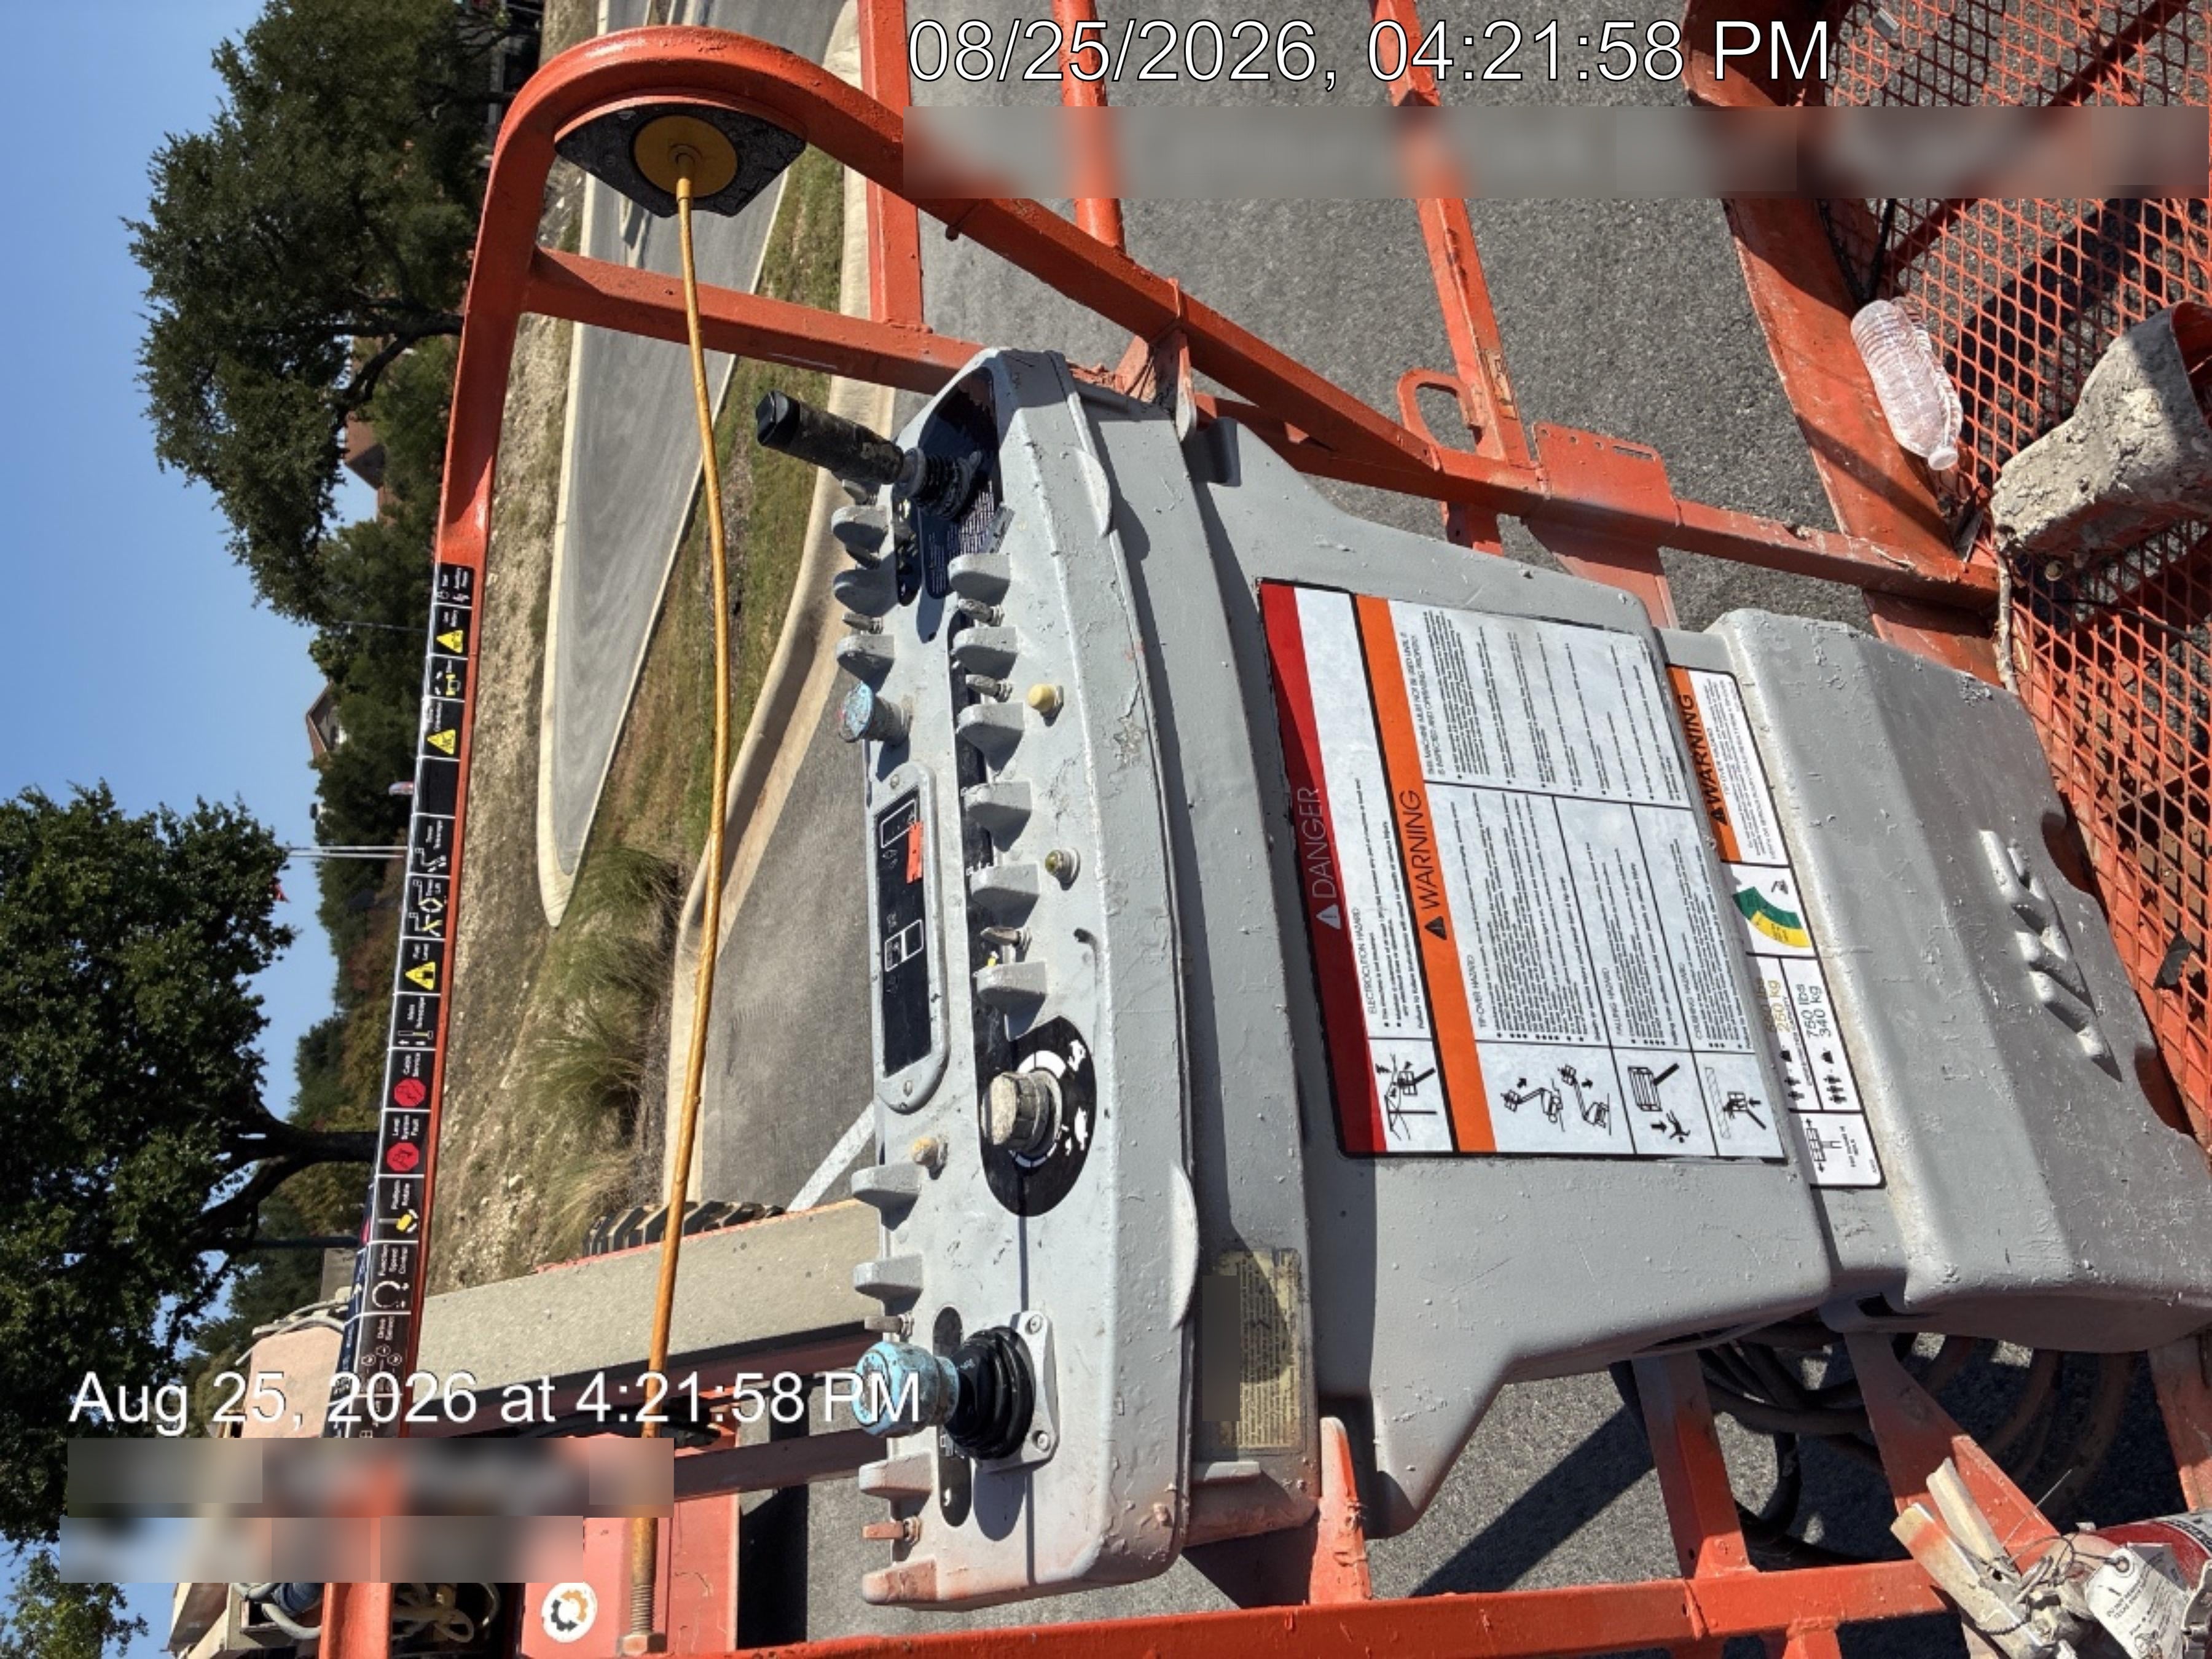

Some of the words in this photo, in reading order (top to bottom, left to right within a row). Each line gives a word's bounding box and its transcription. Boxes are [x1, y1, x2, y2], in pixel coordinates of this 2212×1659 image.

[1679, 694, 1720, 805] WARNING
[1296, 786, 1337, 898] DANGER
[1399, 790, 1440, 910] WARNING
[1349, 907, 1363, 940] HAZARD
[1357, 944, 1378, 1014] ELECTROCUTION
[1768, 980, 1781, 997] kg
[1796, 984, 1810, 1004] lbs
[1808, 986, 1822, 1003] kg
[1771, 1003, 1789, 1032] 250
[1801, 1010, 1818, 1038] 750
[1813, 1008, 1832, 1037] 340
[412, 1052, 422, 1077] Service
[411, 1118, 420, 1136] Fault
[377, 1244, 388, 1276] Function
[388, 1248, 398, 1272] Speed
[398, 1247, 408, 1274] Control
[377, 1319, 386, 1339] Drive
